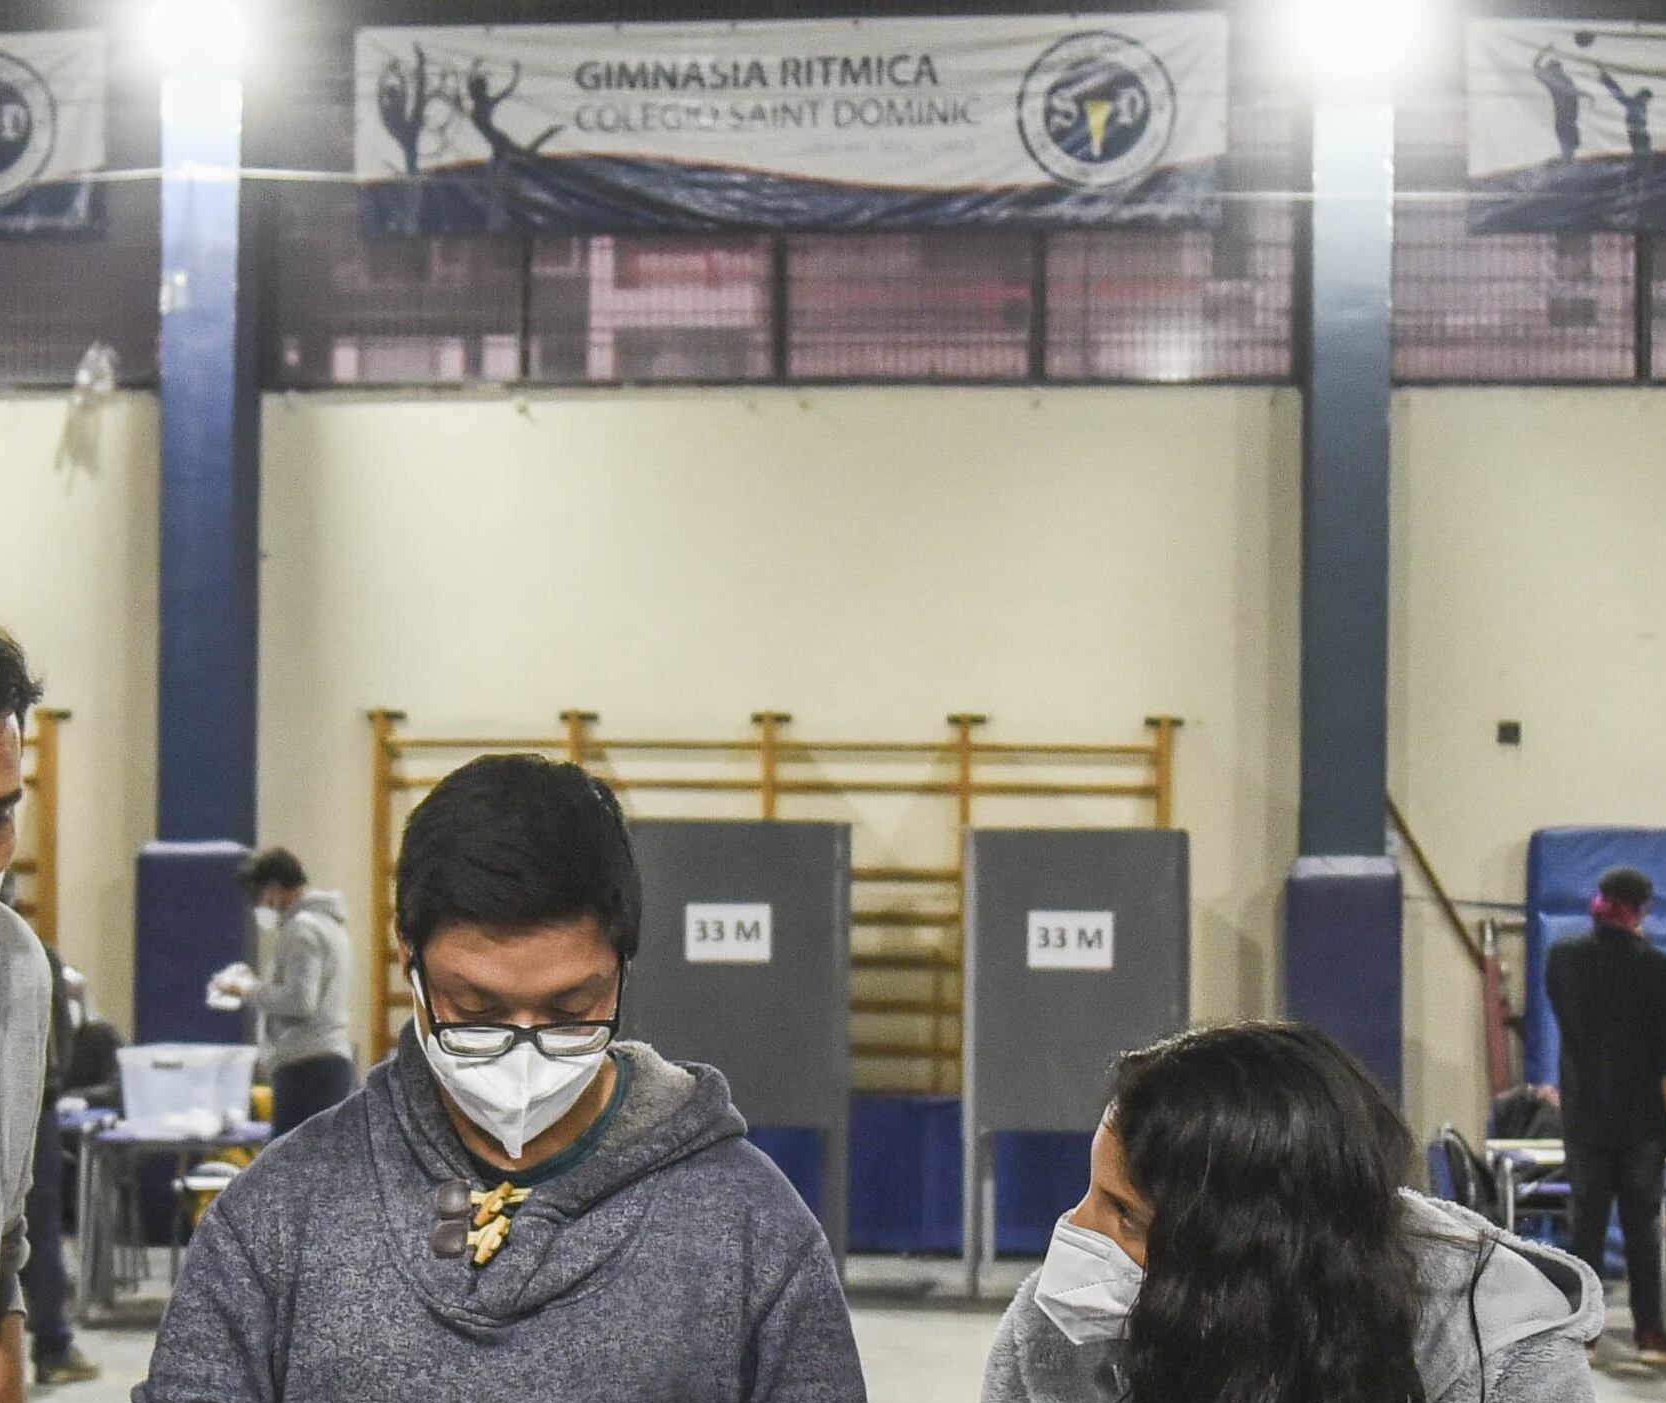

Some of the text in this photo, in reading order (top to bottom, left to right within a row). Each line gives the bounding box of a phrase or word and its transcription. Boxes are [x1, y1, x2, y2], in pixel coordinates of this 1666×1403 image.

[574, 54, 939, 93] GIMNASIA RITMICA
[573, 95, 975, 132] COLEGIO SAINT DOMINIC
[694, 920, 761, 943] 33 M
[1036, 926, 1104, 949] 33 M
